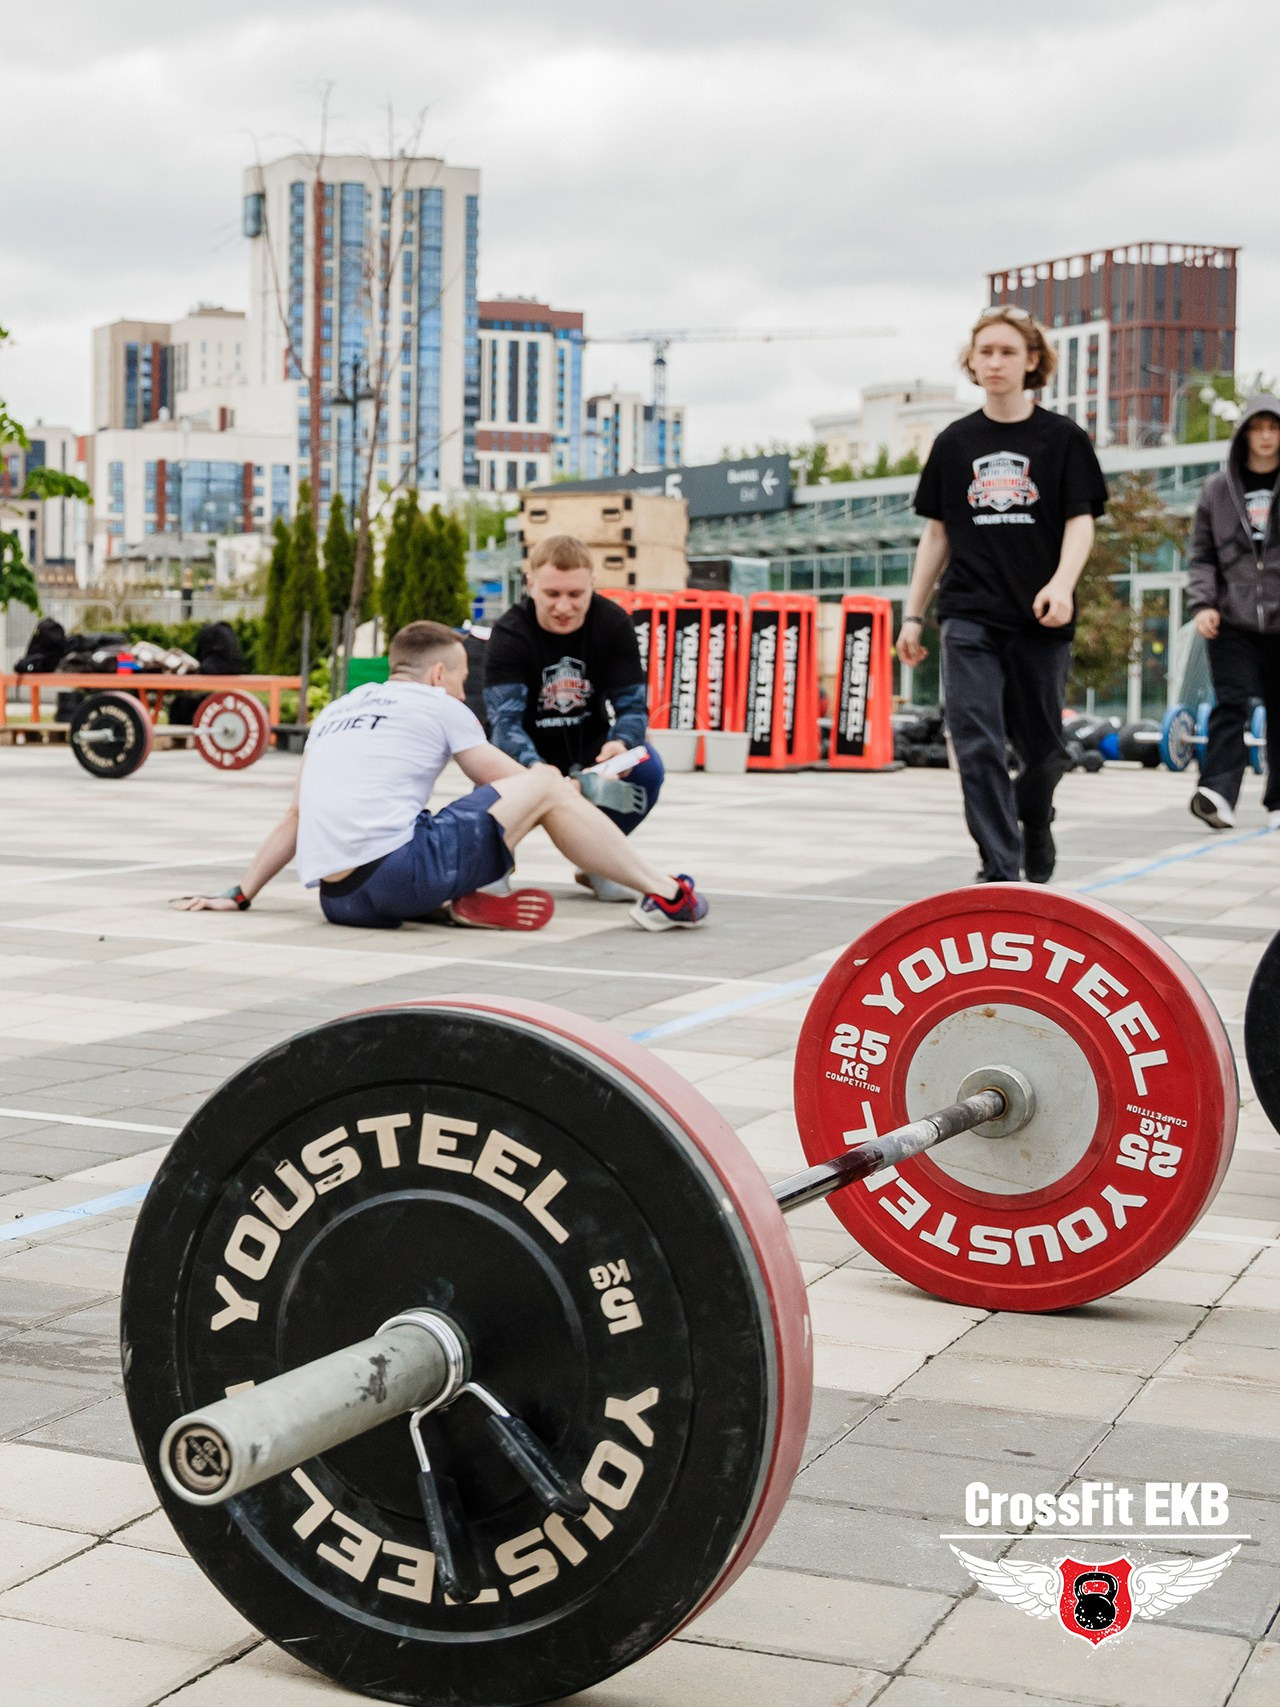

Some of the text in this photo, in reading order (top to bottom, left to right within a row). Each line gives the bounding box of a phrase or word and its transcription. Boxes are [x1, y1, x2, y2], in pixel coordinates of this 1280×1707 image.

[972, 513, 1036, 526] YOUSTEEL
[754, 624, 777, 742] YOUSTEEL
[846, 626, 871, 742] YOUSTEEL
[861, 932, 1169, 1097] YOUSTEEL
[830, 1023, 891, 1066] 25
[825, 1071, 881, 1094] COMPETITION
[840, 1058, 869, 1081] KG
[1126, 1103, 1188, 1128] COMPETITION
[1139, 1117, 1171, 1141] KG
[1116, 1132, 1183, 1178] 25
[210, 1112, 570, 1331] YOUSTEEL
[588, 1258, 632, 1290] KG
[600, 1286, 644, 1335] 5
